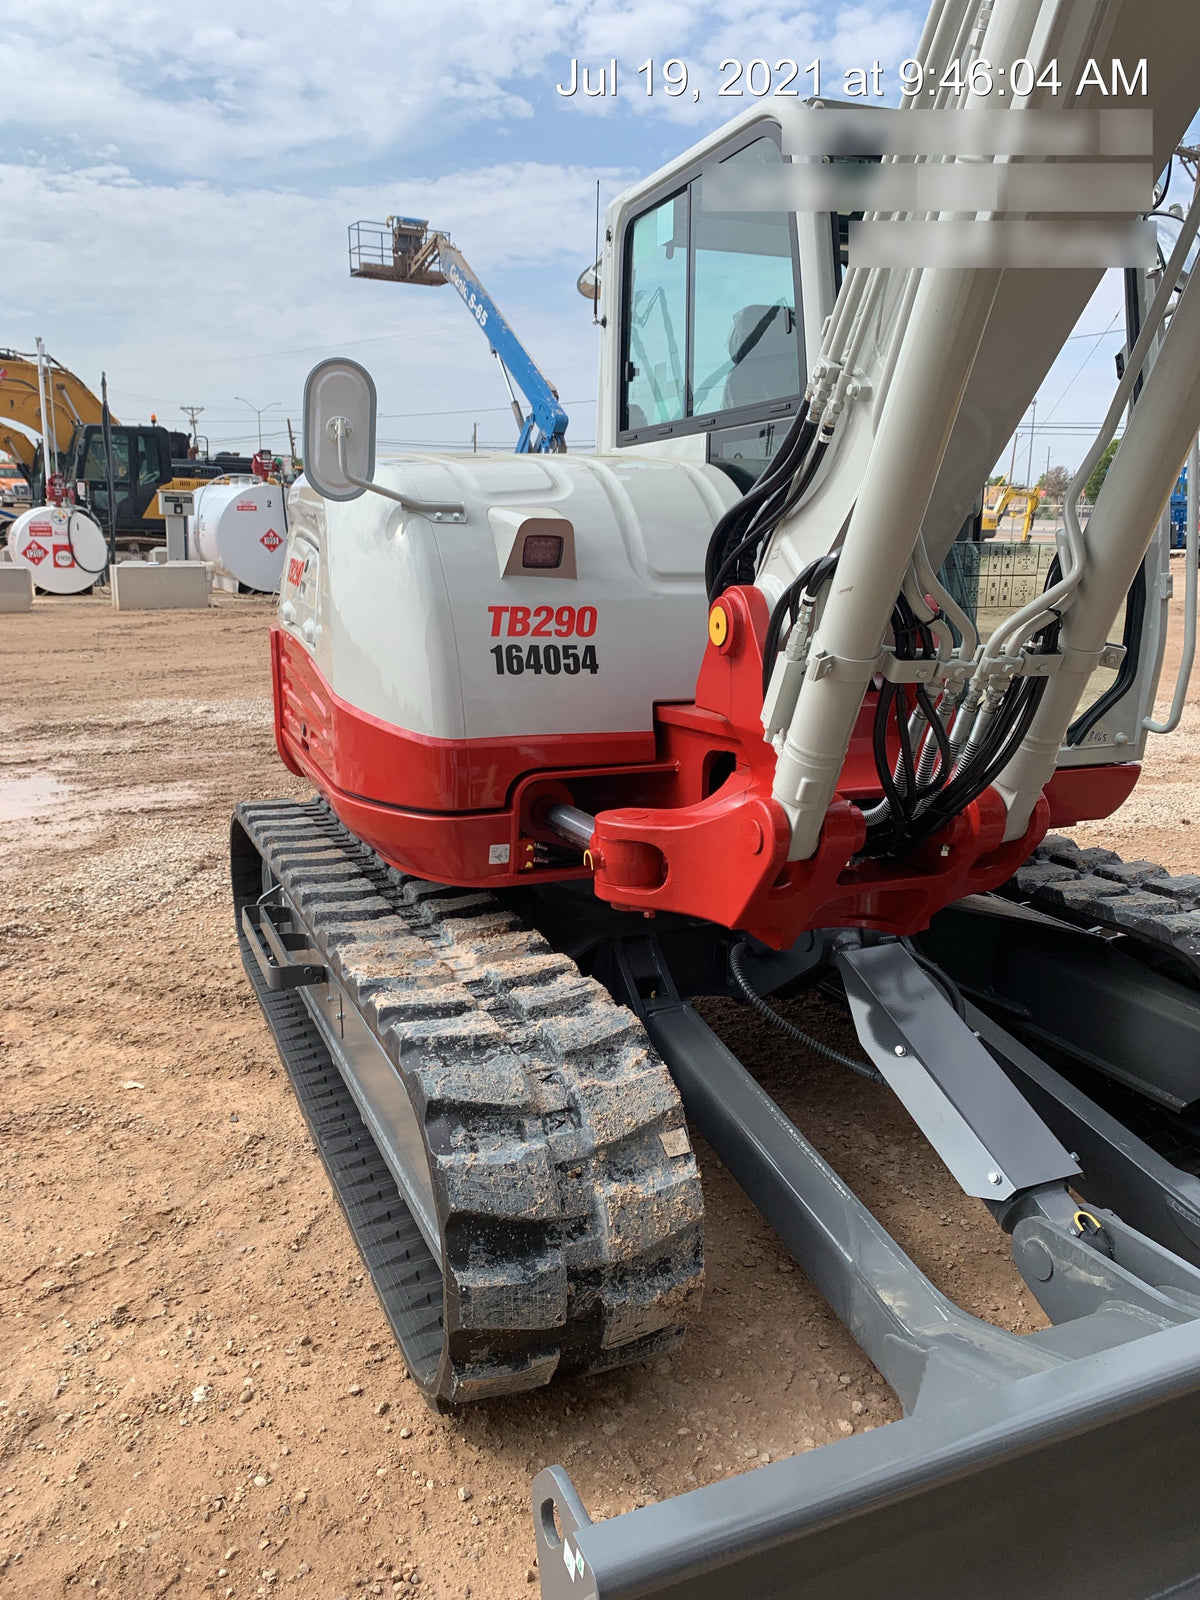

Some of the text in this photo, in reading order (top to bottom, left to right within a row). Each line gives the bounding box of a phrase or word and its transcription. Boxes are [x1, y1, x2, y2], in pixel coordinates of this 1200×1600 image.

[468, 293, 489, 327] S-65
[266, 500, 273, 508] 2
[488, 605, 598, 637] TB290
[490, 644, 599, 675] 164054
